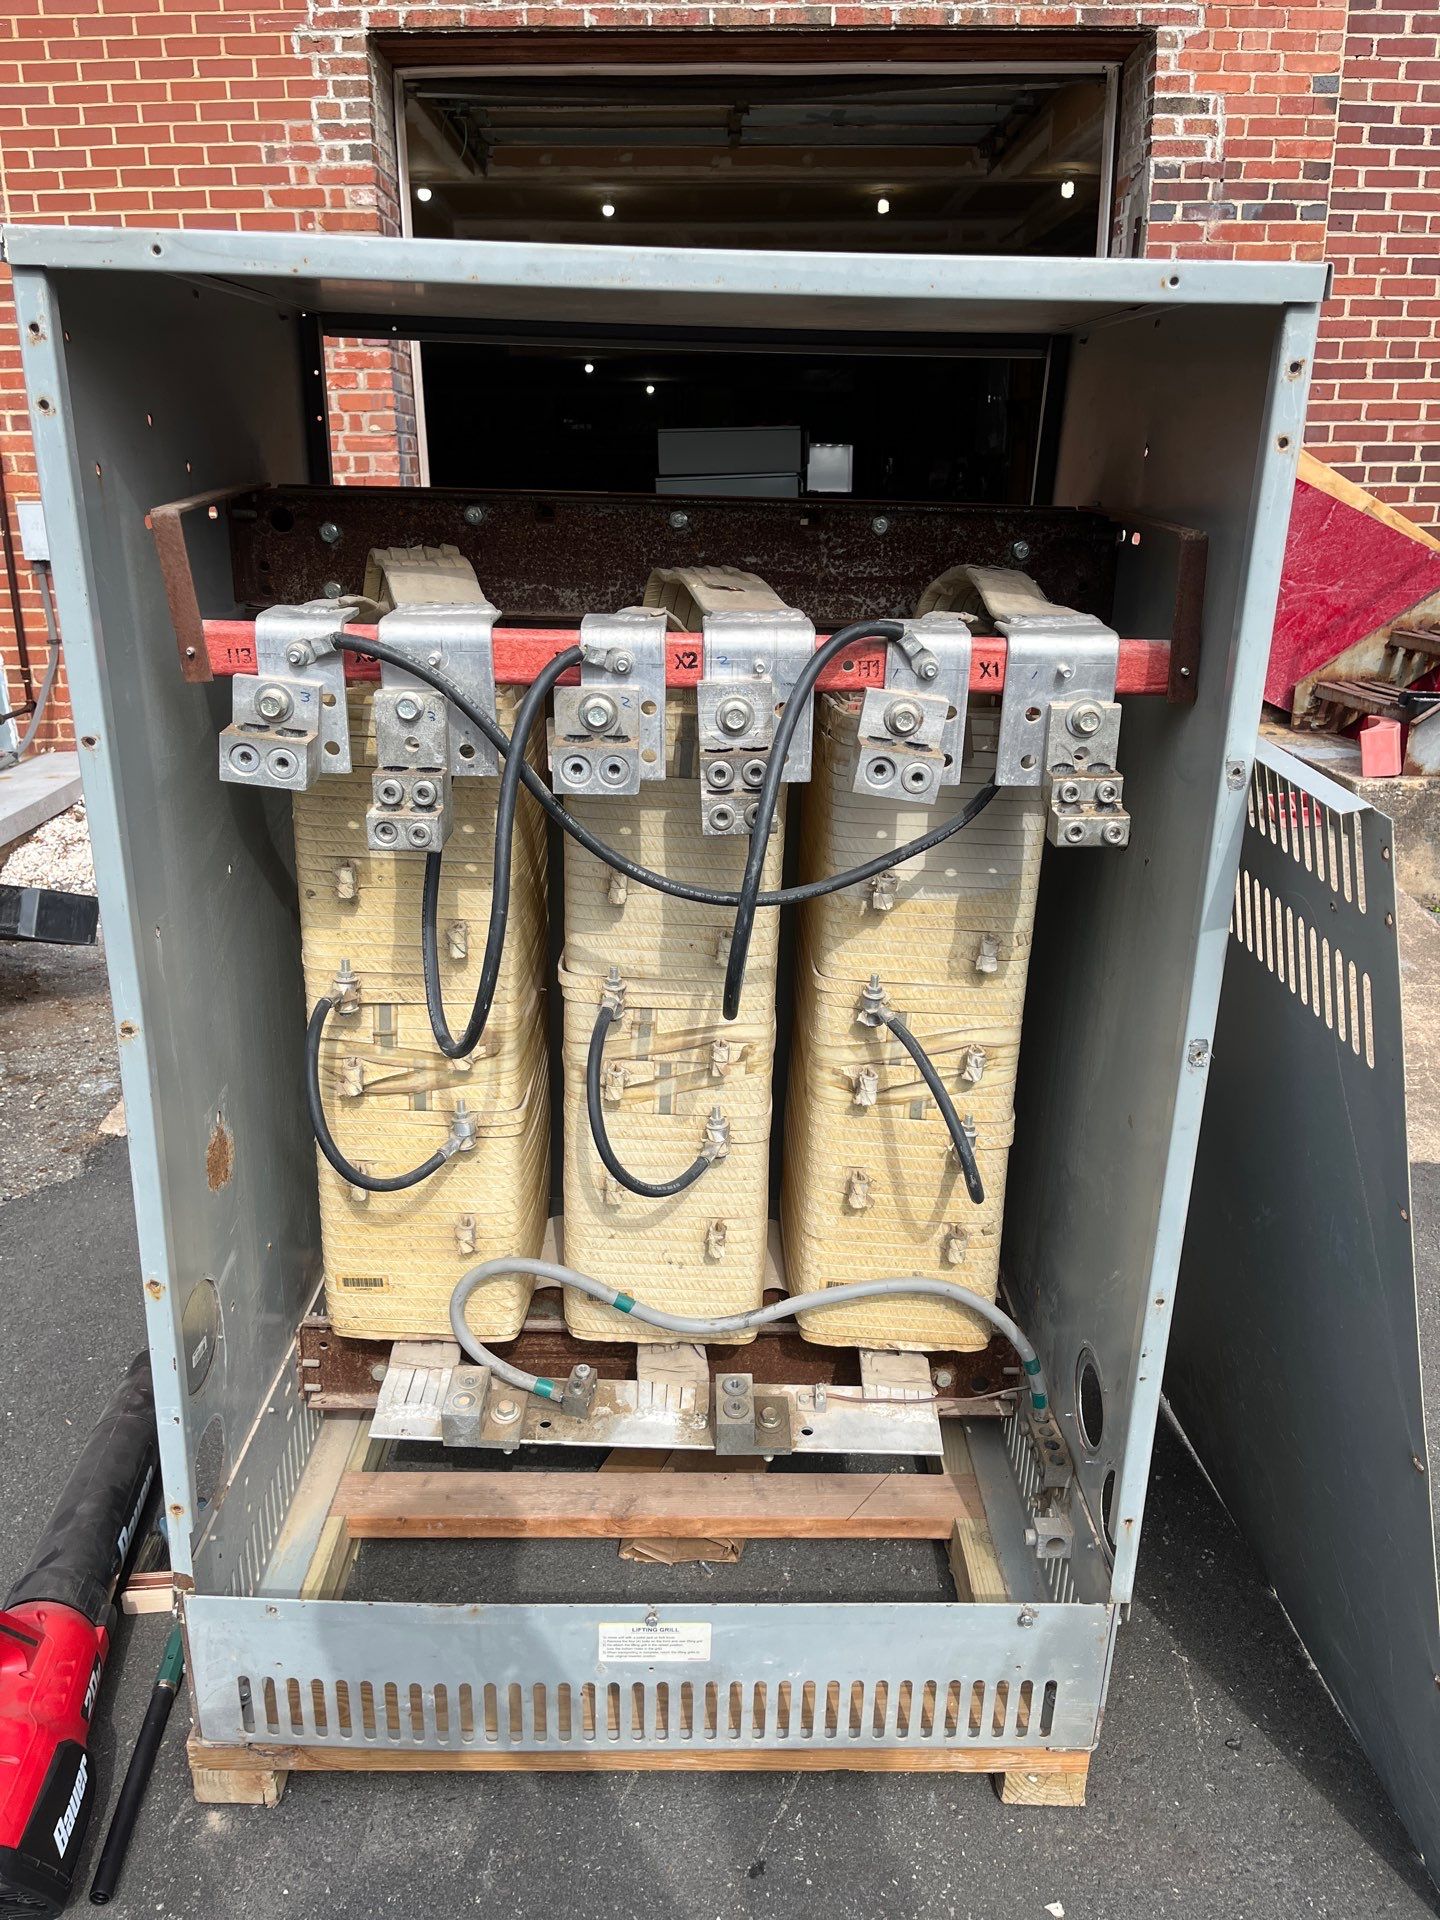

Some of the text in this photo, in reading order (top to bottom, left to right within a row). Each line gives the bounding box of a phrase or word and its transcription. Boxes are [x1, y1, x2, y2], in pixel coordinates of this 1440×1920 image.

[674, 650, 699, 670] X2
[716, 655, 731, 666] 2
[978, 660, 999, 680] X1
[300, 691, 311, 703] 3
[620, 695, 632, 709] 2
[53, 1752, 88, 1860] Bauer
